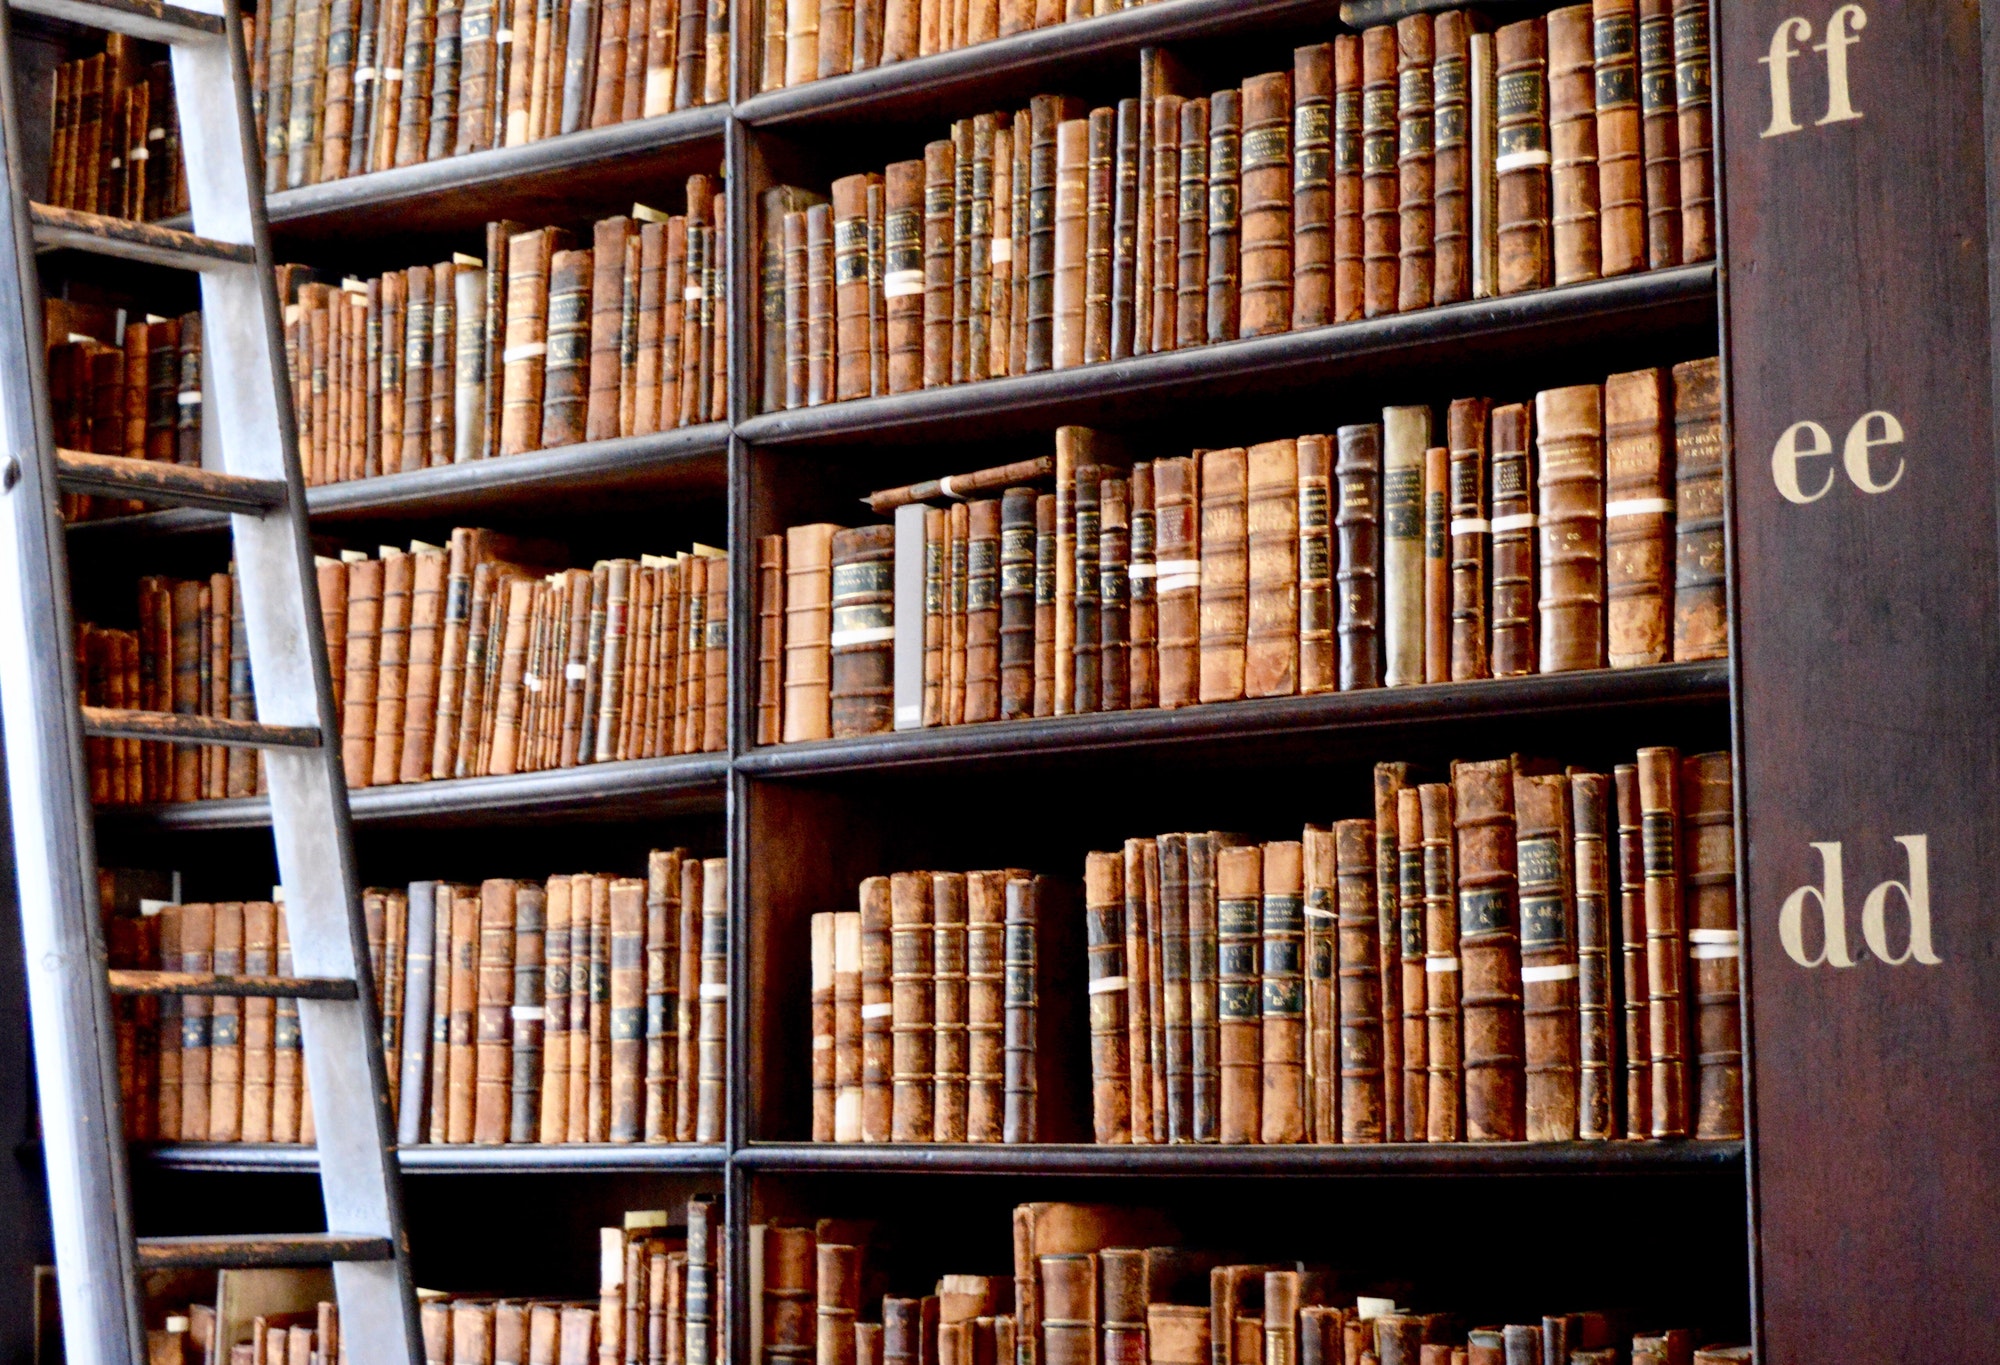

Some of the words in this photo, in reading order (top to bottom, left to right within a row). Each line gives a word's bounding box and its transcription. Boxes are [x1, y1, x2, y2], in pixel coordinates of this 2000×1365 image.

[1757, 3, 1868, 139] ff
[1770, 410, 1905, 505] ee
[1777, 833, 1943, 969] dd
